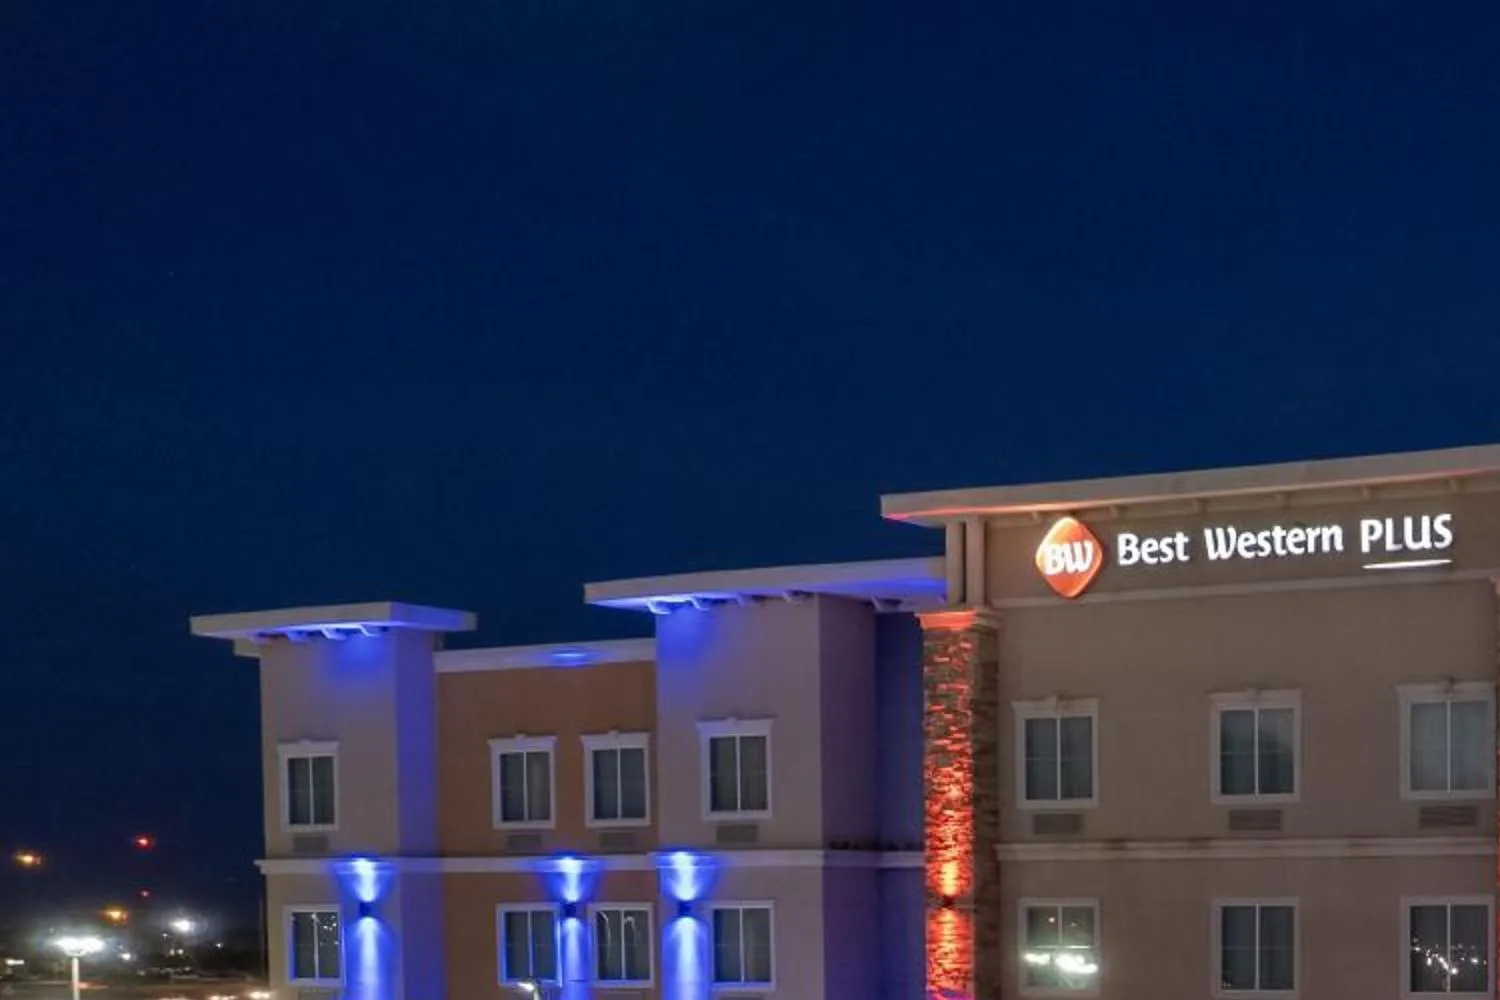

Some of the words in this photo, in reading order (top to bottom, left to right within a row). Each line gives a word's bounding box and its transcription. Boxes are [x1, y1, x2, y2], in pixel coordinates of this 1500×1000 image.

[1043, 542, 1095, 576] BW
[1117, 531, 1190, 566] Best
[1204, 523, 1344, 561] Western
[1360, 513, 1454, 553] PLUS
